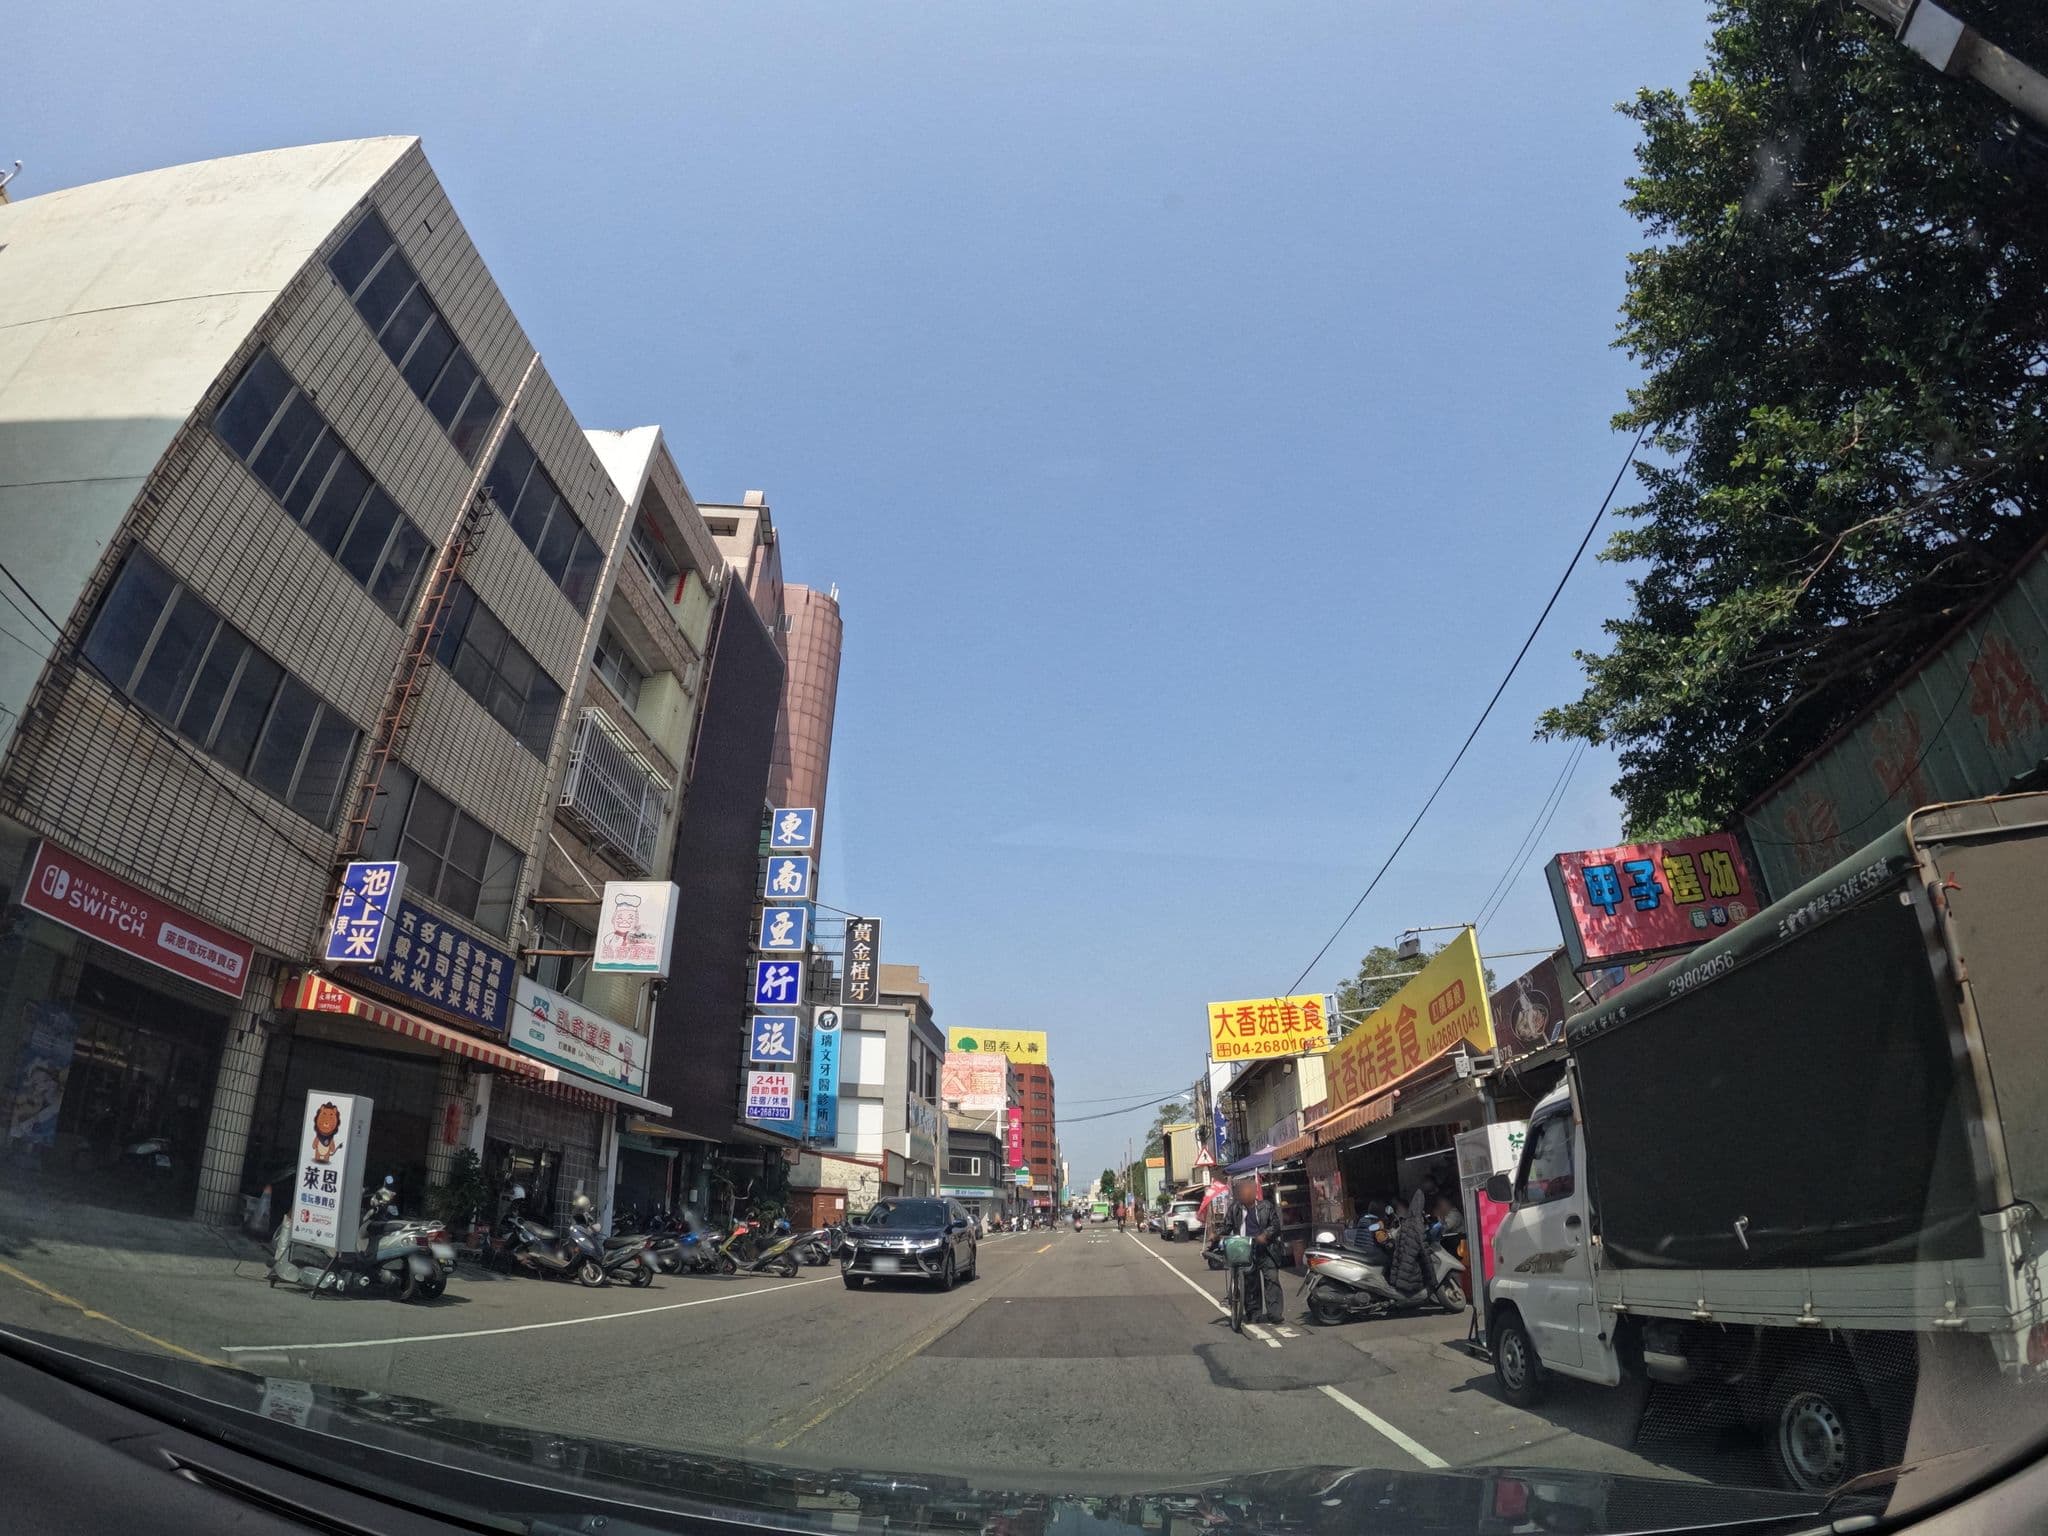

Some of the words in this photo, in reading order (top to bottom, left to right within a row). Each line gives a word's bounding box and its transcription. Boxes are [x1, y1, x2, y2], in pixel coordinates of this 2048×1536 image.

[74, 878, 148, 920] NINTENDO
[1582, 849, 1741, 916] 甲子選物
[69, 890, 145, 937] SWITCH
[334, 887, 357, 936] 台東
[345, 868, 391, 956] 池上米
[1690, 904, 1746, 929] 福利社
[409, 922, 438, 992] 多力米
[849, 923, 873, 1001] 黃金植牙
[1668, 950, 1735, 997] 29802056
[1214, 1000, 1323, 1039] 大香菇美食
[983, 1040, 1039, 1053] 國泰人壽
[1328, 1004, 1424, 1110] 大香菇美食
[756, 1076, 785, 1085] 24H
[816, 1034, 833, 1121] 瑞文牙醫診所
[303, 1166, 338, 1193] 萊恩
